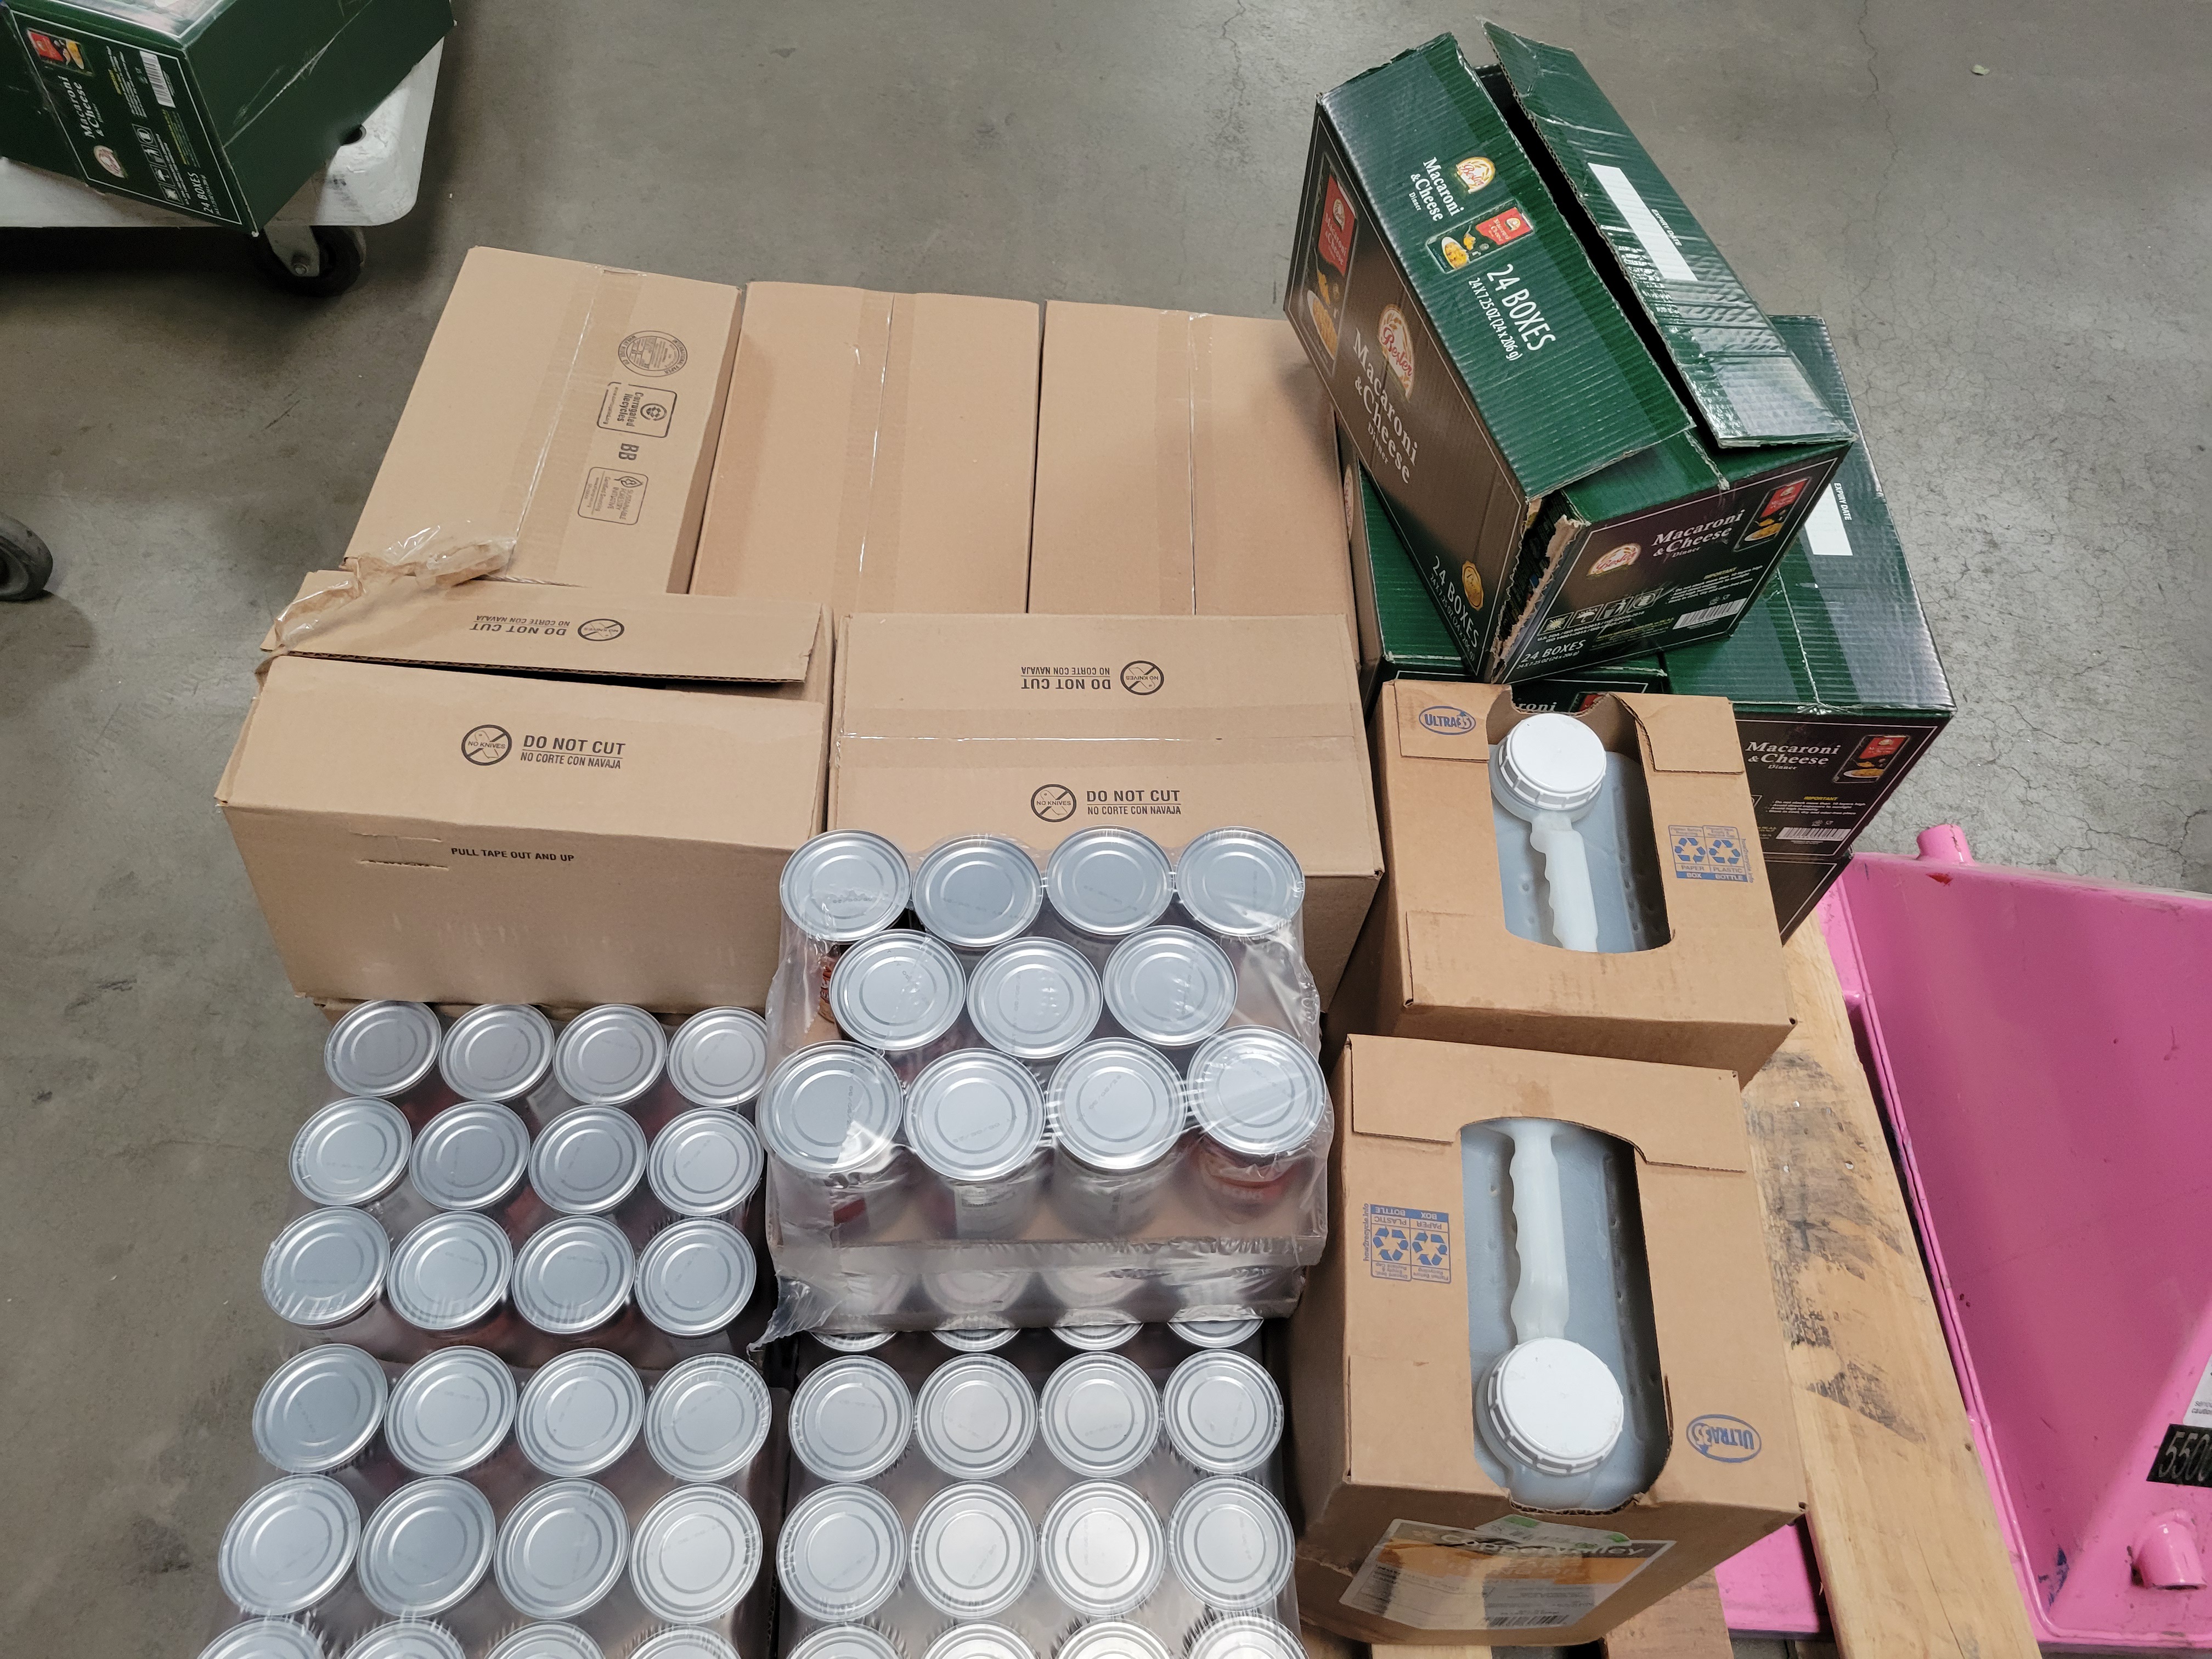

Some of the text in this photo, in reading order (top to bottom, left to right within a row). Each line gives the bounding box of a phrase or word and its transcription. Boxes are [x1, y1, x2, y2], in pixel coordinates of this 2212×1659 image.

[58, 75, 95, 139] Macaroni
[188, 171, 208, 201] BOXES
[1423, 156, 1464, 217] Macaroni
[203, 201, 214, 214] 24
[1408, 192, 1422, 211] Dinner
[1651, 208, 1683, 246] EXPIRY DATE
[1487, 263, 1556, 351] 24 BOXES
[1353, 327, 1418, 466] Macaroni
[617, 393, 634, 422] Recycles
[626, 392, 644, 427] Corrugated
[618, 443, 640, 461] BB
[1367, 421, 1389, 464] Dinner
[607, 486, 619, 510] INITIATIVE
[615, 487, 627, 510] FORESTRY
[619, 488, 634, 520] SUSTAINABLE
[1833, 482, 1853, 521] EXPIRY DATE
[1651, 509, 1746, 547] Macaroni
[1672, 546, 1701, 558] Dinner
[1433, 555, 1446, 586] 24
[1447, 582, 1479, 648] BOXES
[469, 623, 567, 636] DO NOT CUT
[1520, 639, 1587, 663] 24 BOXES
[1021, 666, 1051, 675] NAVAJA
[1071, 667, 1097, 675] CORTE
[1099, 667, 1110, 675] NO
[1021, 678, 1111, 690] DO NOT CUT
[1514, 702, 1558, 712] roni
[523, 735, 626, 755] DO NOT CUT
[1744, 741, 1842, 755] Macaroni
[521, 752, 621, 769] NO CORTE CON NAVAJA
[1086, 790, 1180, 802] DO NOT CUT
[1087, 806, 1182, 815] NO CORTE CON NAVAJA
[450, 847, 575, 862] PULL TAPE OUT AND UP
[1374, 1216, 1407, 1225] PLASTIC
[1375, 1207, 1406, 1216] BOTTLE
[1417, 1221, 1442, 1229] PAPER
